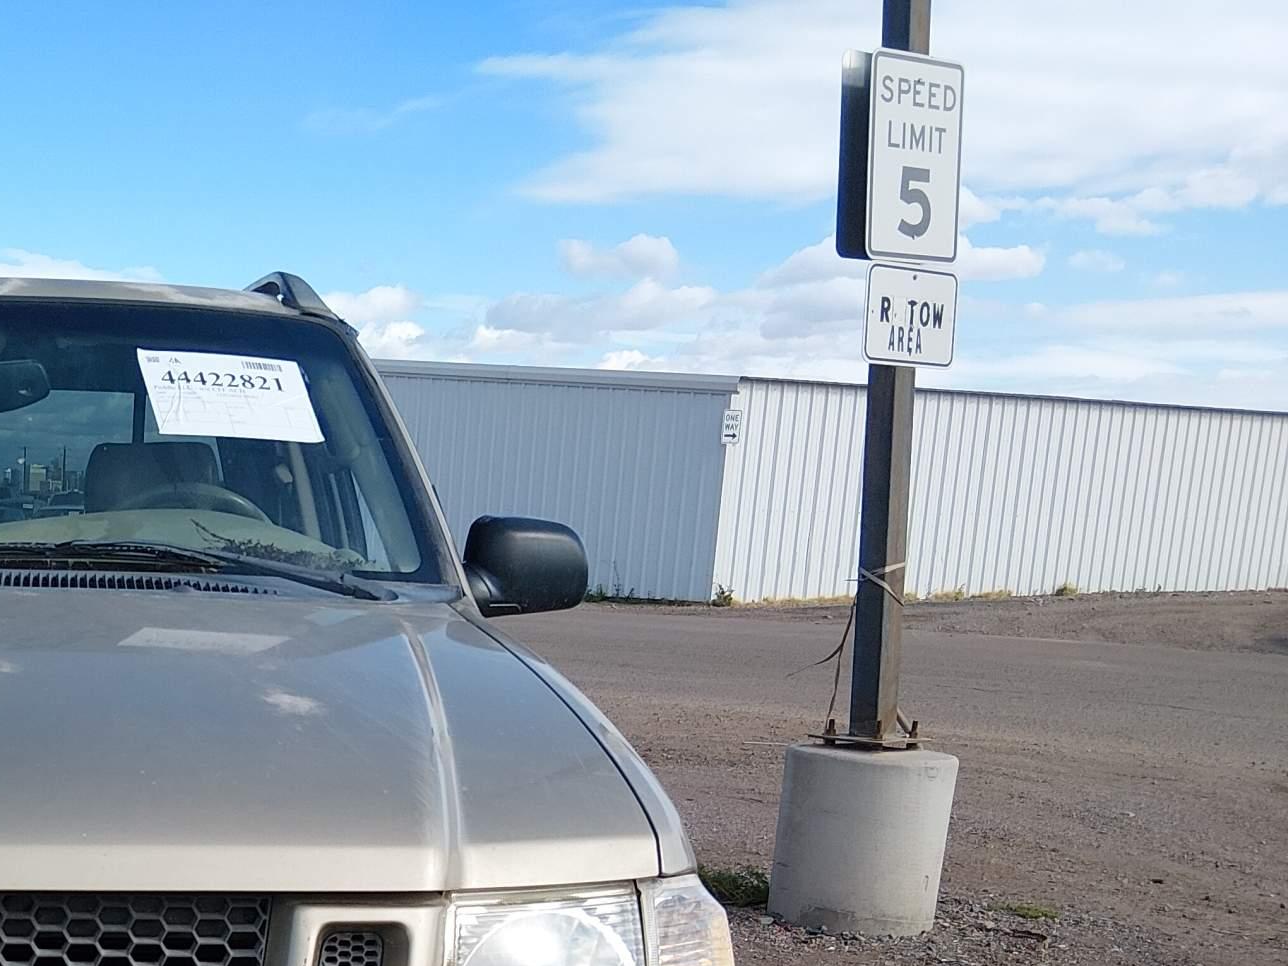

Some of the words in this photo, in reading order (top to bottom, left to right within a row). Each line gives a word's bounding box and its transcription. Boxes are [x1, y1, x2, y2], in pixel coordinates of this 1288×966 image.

[880, 75, 957, 113] SPEED
[887, 119, 947, 154] LIMIT
[897, 165, 932, 240] 5
[907, 299, 944, 329] TOW
[888, 325, 922, 355] AREA
[161, 369, 285, 393] 44422821
[724, 423, 739, 431] WAY
[725, 414, 740, 422] ONE
